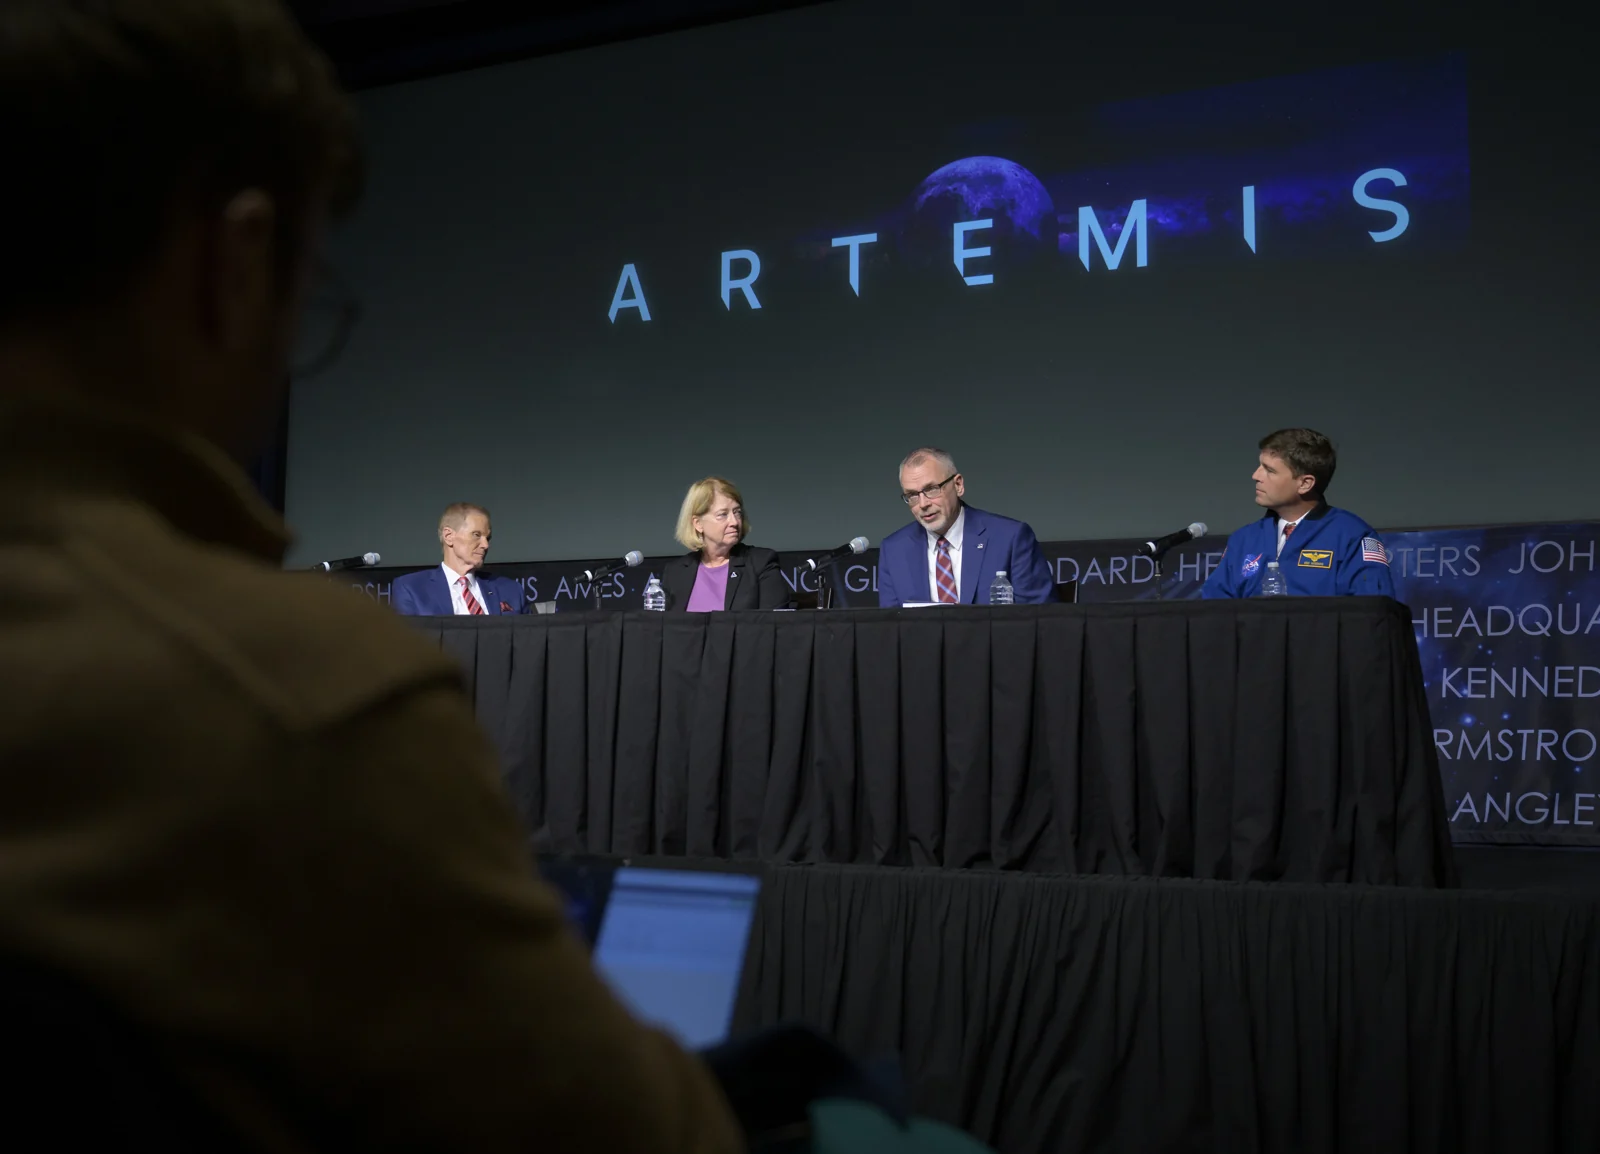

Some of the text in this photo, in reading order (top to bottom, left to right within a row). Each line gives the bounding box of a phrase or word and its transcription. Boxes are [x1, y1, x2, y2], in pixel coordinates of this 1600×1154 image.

[607, 166, 1412, 324] ARTEMIS
[1508, 540, 1596, 575] JOH
[1441, 666, 1600, 699] KENNED
[1433, 728, 1597, 762] RMSTRO
[1448, 791, 1600, 826] ANGLE
